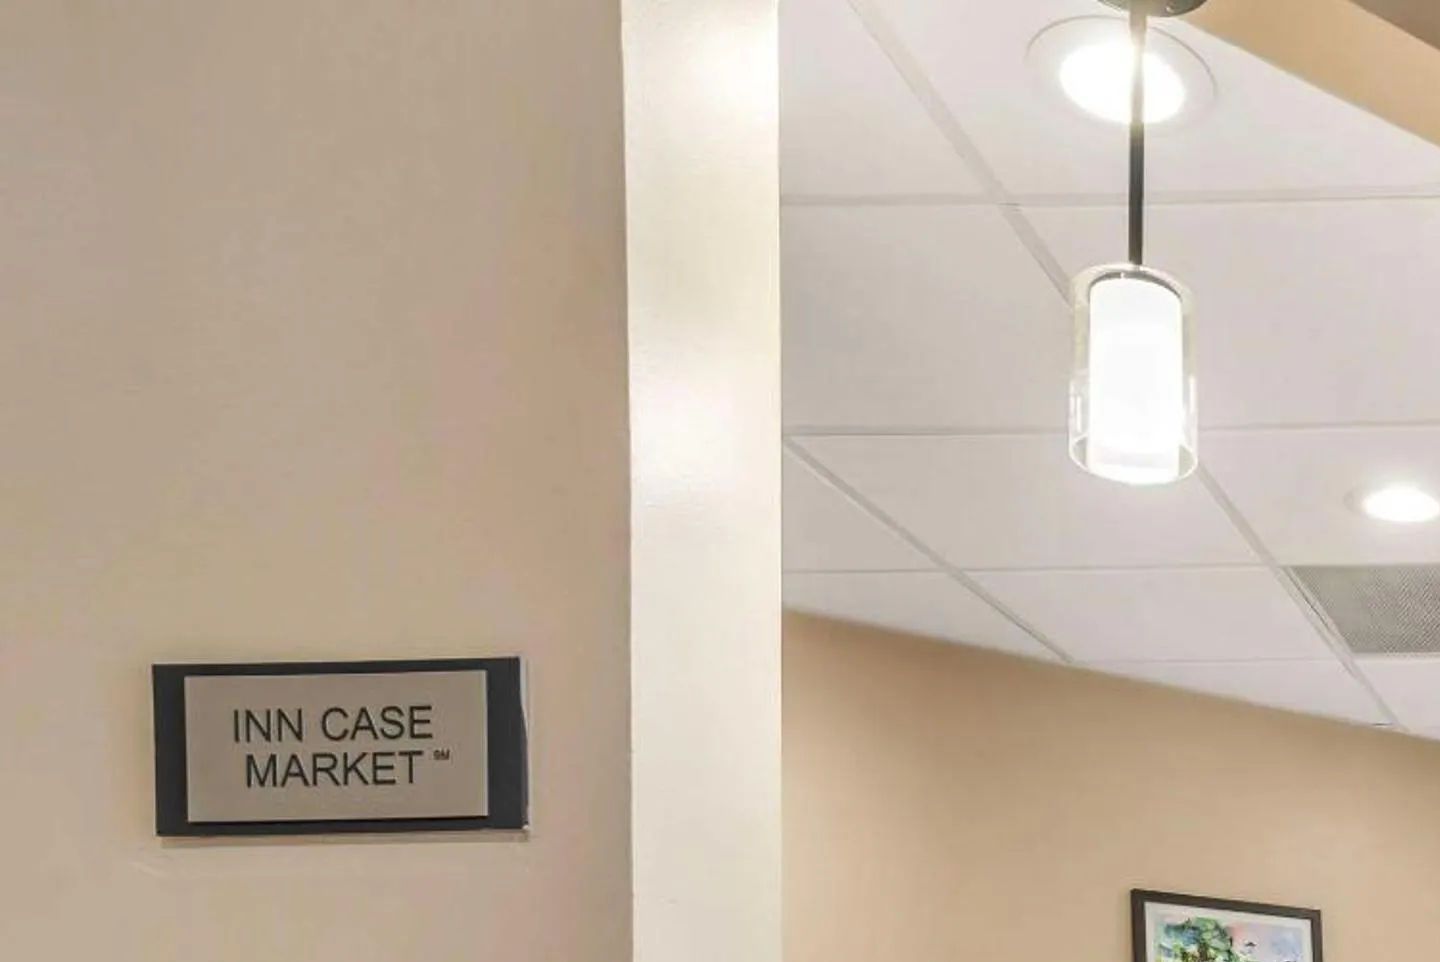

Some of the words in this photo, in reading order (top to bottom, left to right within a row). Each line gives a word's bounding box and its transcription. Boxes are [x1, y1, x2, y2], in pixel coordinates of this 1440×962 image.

[233, 709, 303, 743] INN
[321, 705, 433, 741] CASE
[245, 750, 423, 788] MARKET
